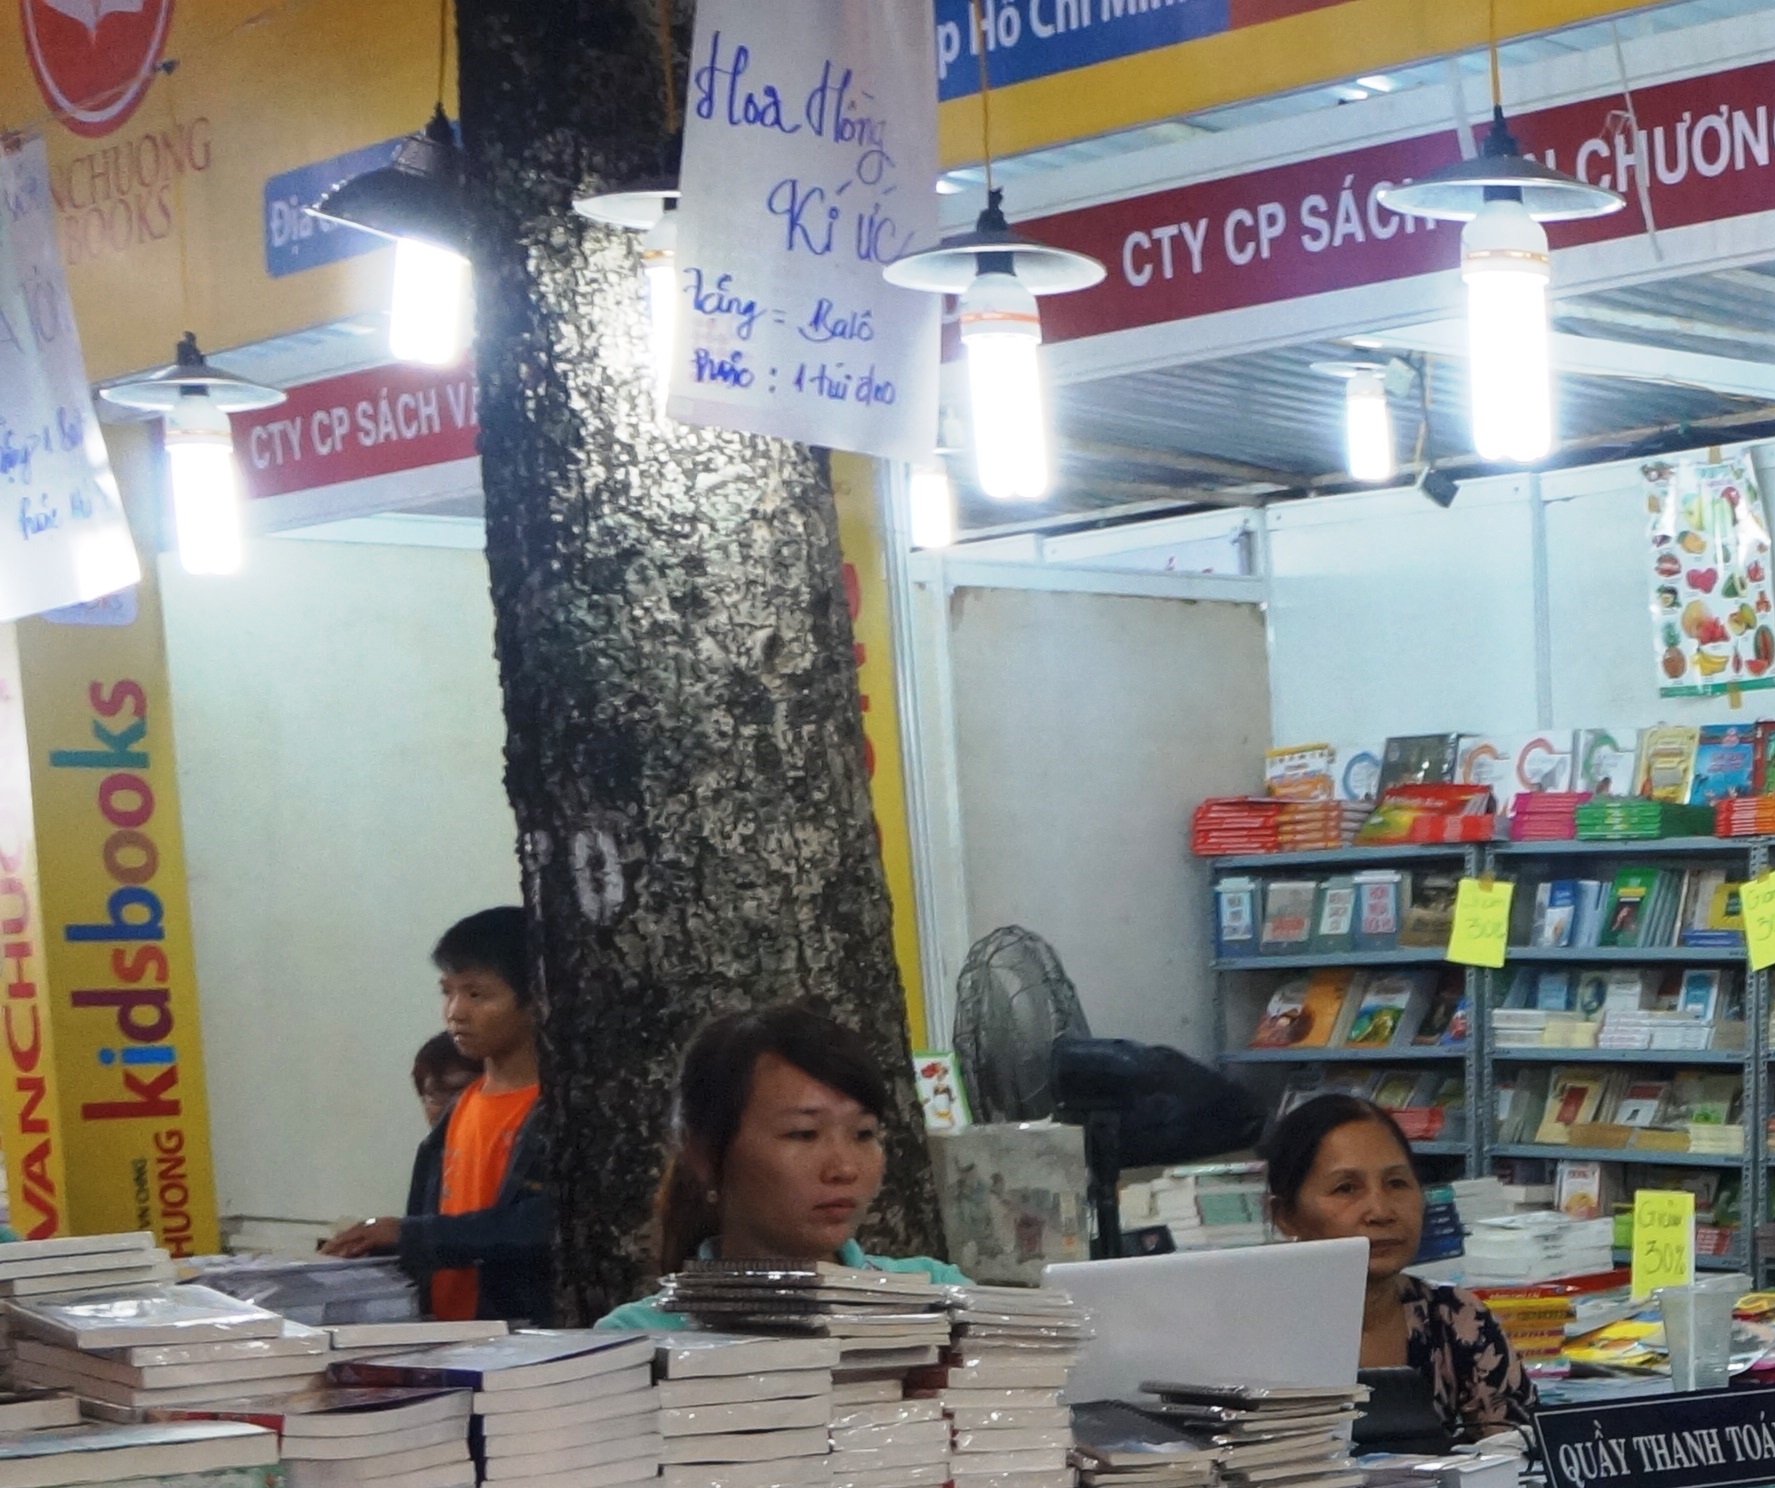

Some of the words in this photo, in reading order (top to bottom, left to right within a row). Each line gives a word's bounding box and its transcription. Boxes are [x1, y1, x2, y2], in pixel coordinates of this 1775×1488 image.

[1122, 217, 1210, 288] CTY
[1223, 202, 1287, 267] CP
[250, 421, 301, 471] CTY
[311, 410, 351, 456] CP
[360, 384, 440, 444] SÁCH
[50, 677, 183, 1120] kidsbooks
[1643, 1239, 1686, 1277] 30%
[1632, 1427, 1727, 1474] THANH
